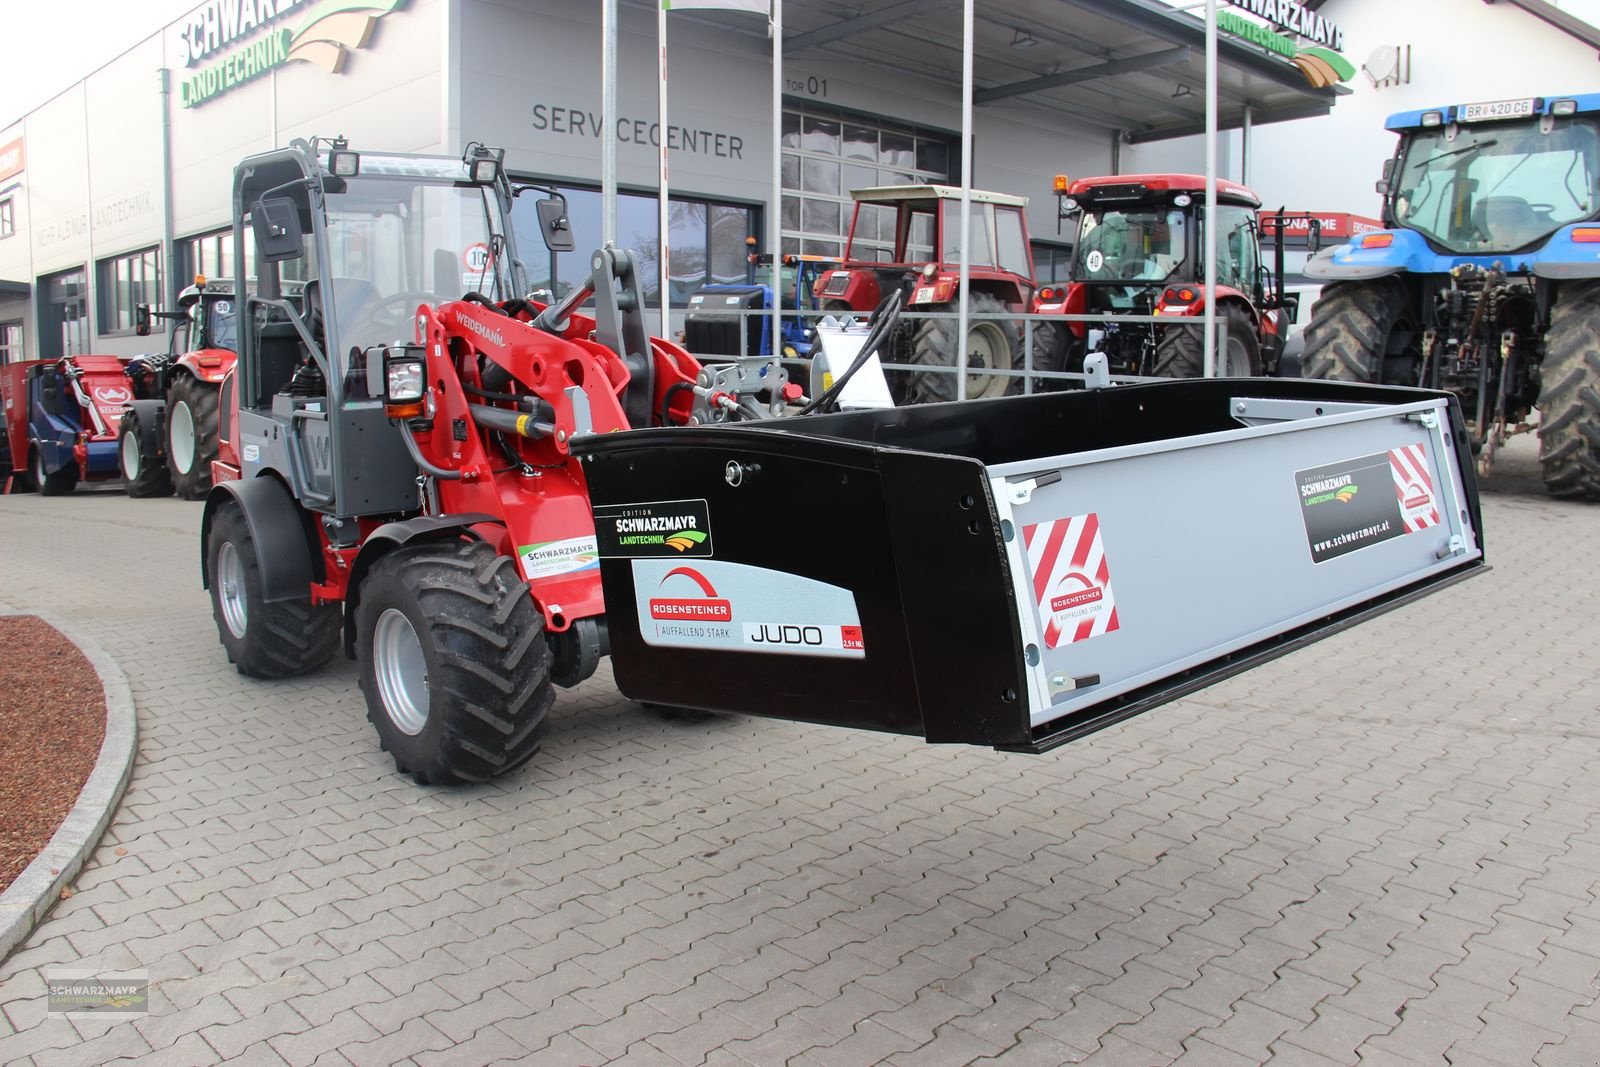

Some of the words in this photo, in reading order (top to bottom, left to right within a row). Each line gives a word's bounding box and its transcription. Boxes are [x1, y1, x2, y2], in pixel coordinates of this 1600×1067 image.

[180, 27, 291, 109] LANDTECHNIK
[786, 79, 804, 92] TOR
[807, 76, 827, 97] 01
[1468, 106, 1482, 117] BR
[1490, 103, 1511, 114] 420
[532, 104, 743, 160] SERVCECENTER
[1089, 256, 1098, 267] 40
[218, 303, 228, 311] 50
[456, 310, 505, 347] WEIDEMANN
[1301, 475, 1352, 497] SCHWARZMAYR
[1304, 493, 1335, 506] LANDTECHNIK
[622, 509, 652, 517] EDITION
[616, 515, 697, 533] SCHWARZMAYR
[619, 535, 665, 545] LANDTECHNIK
[1313, 520, 1390, 552] www.schwarzmayr.at
[528, 544, 594, 561] SCHWARZMAYR
[1053, 590, 1100, 608] ROSENSTEINER
[653, 604, 727, 615] ROSENSTEINER
[662, 625, 704, 637] AUFFALLEND
[707, 627, 730, 638] STARK
[751, 624, 823, 645] JUDO
